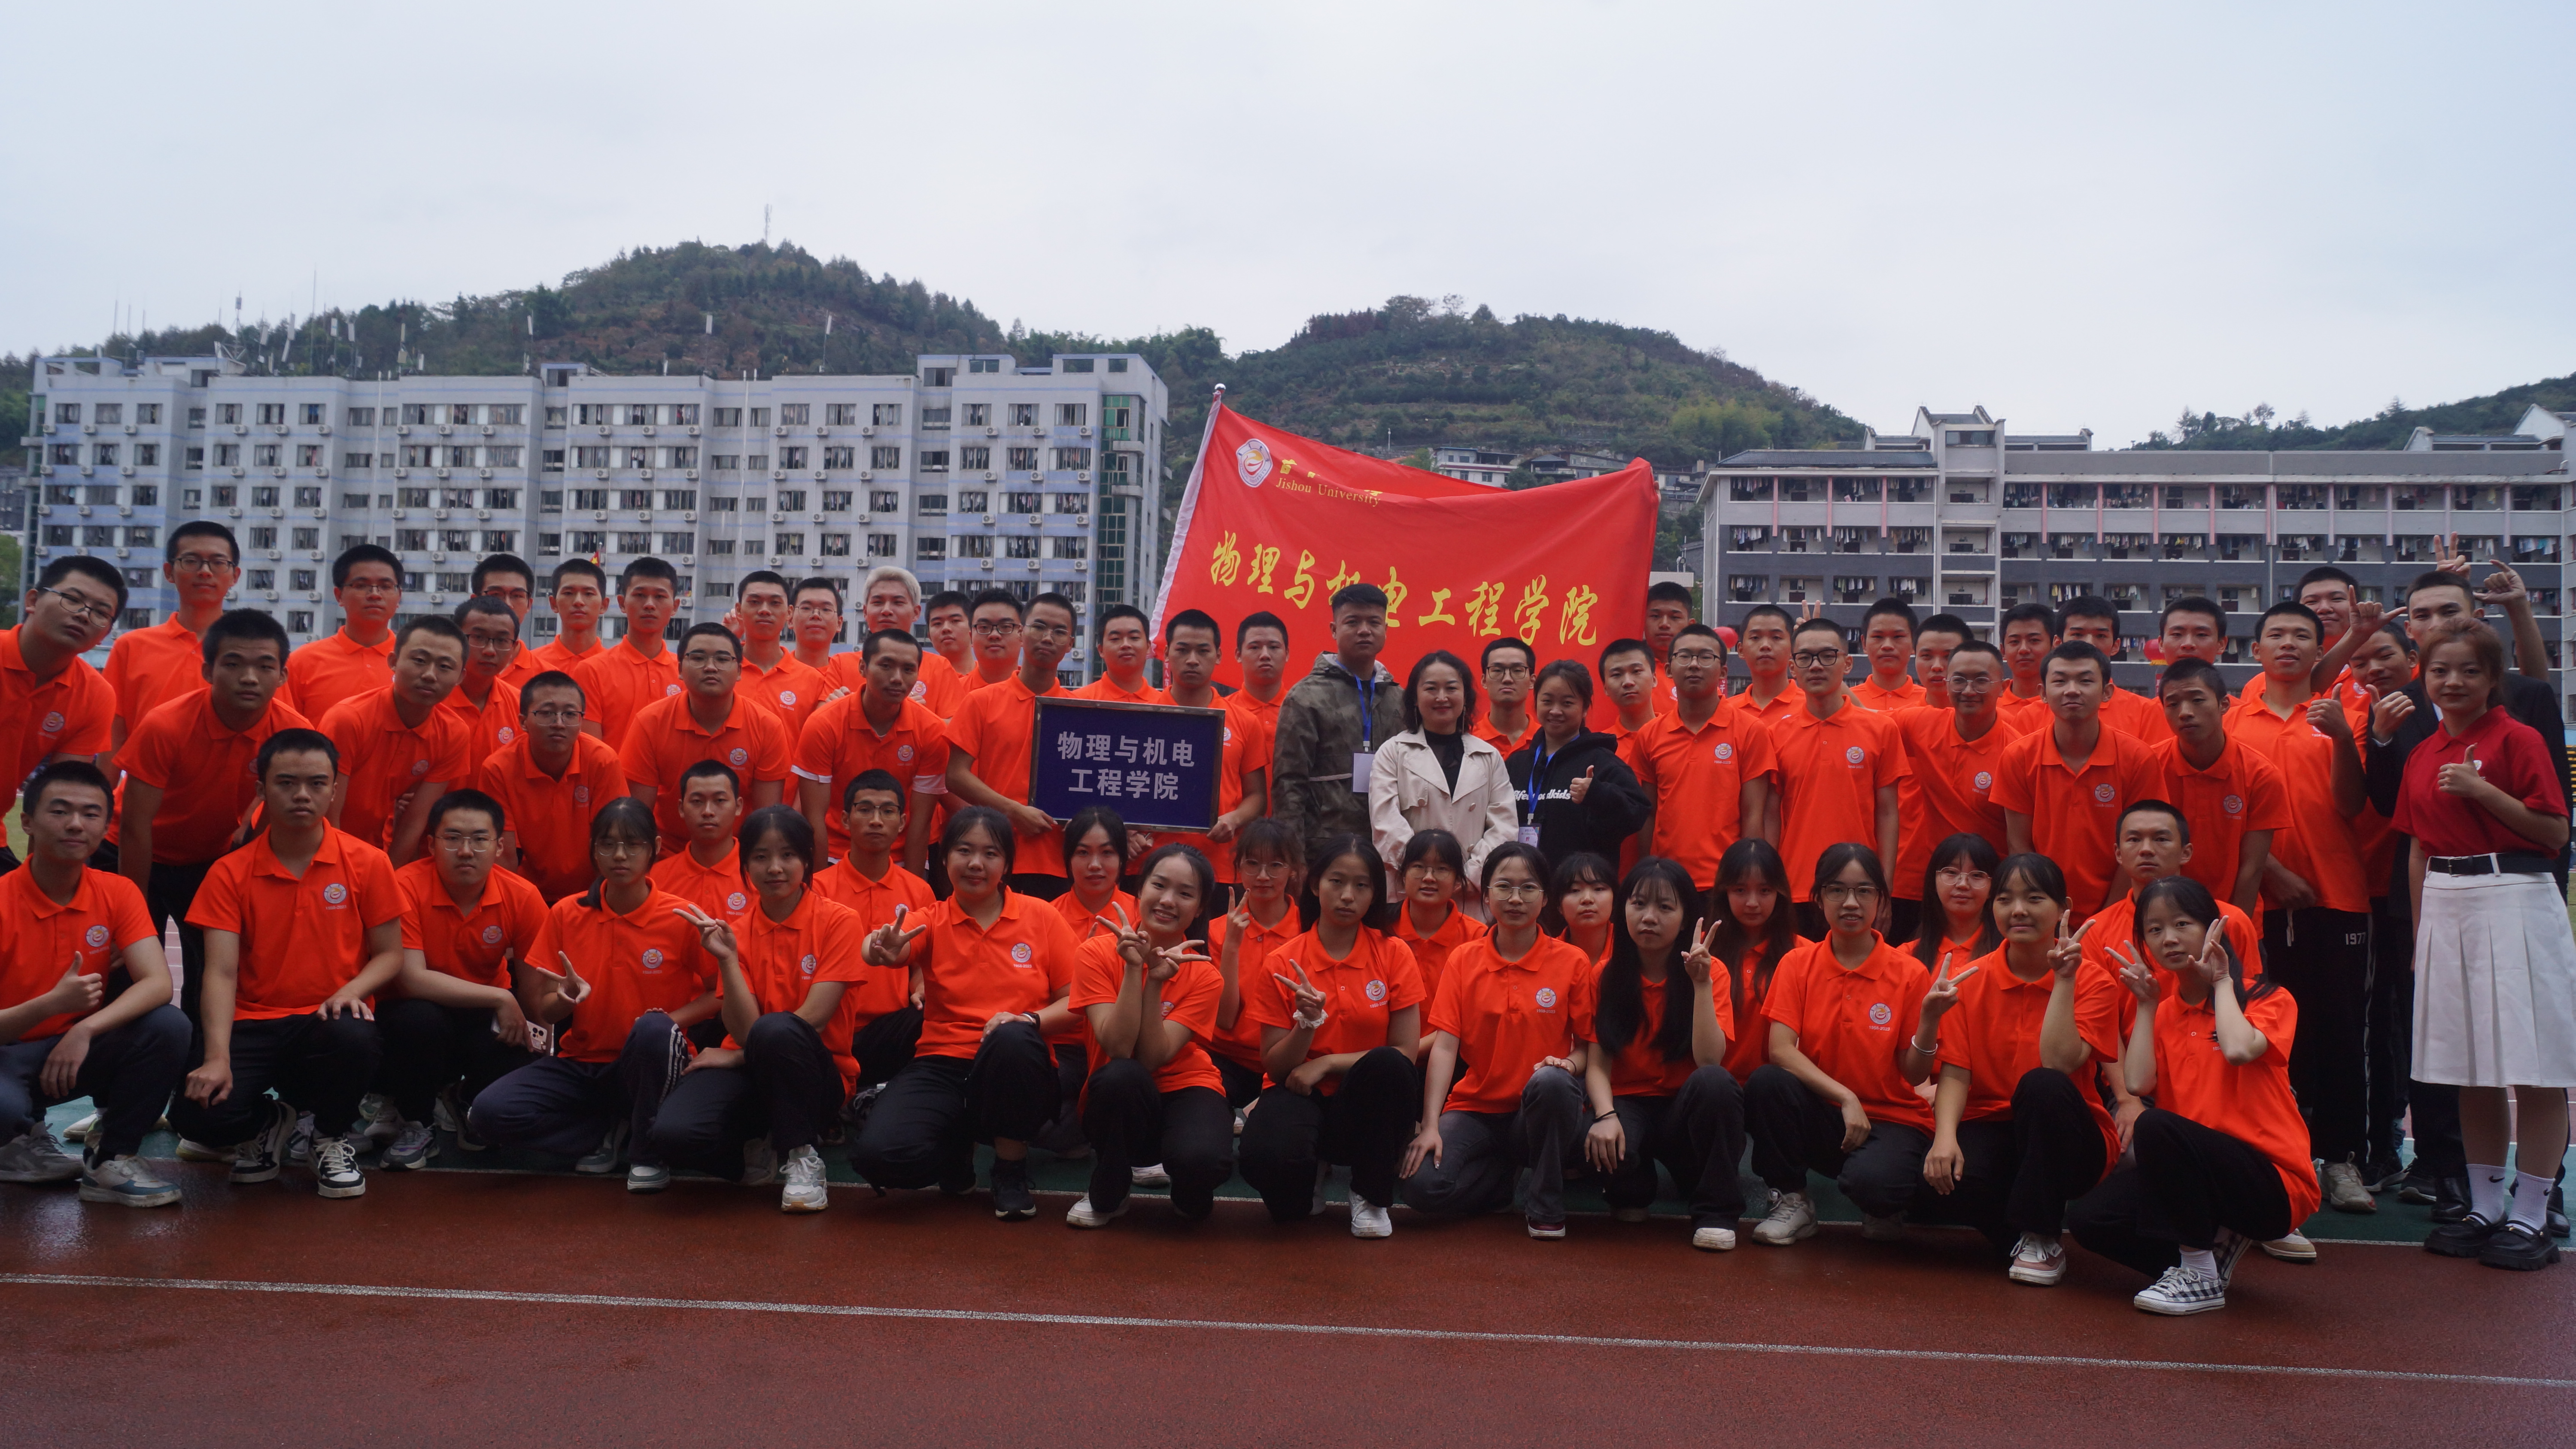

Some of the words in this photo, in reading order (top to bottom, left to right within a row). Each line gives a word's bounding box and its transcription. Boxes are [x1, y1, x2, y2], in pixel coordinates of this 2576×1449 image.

[1276, 477, 1312, 493] Jishou
[1318, 484, 1381, 507] University
[1057, 731, 1195, 767] 物理与机电
[1068, 769, 1179, 800] 工程学院
[2345, 932, 2366, 945] 1977
